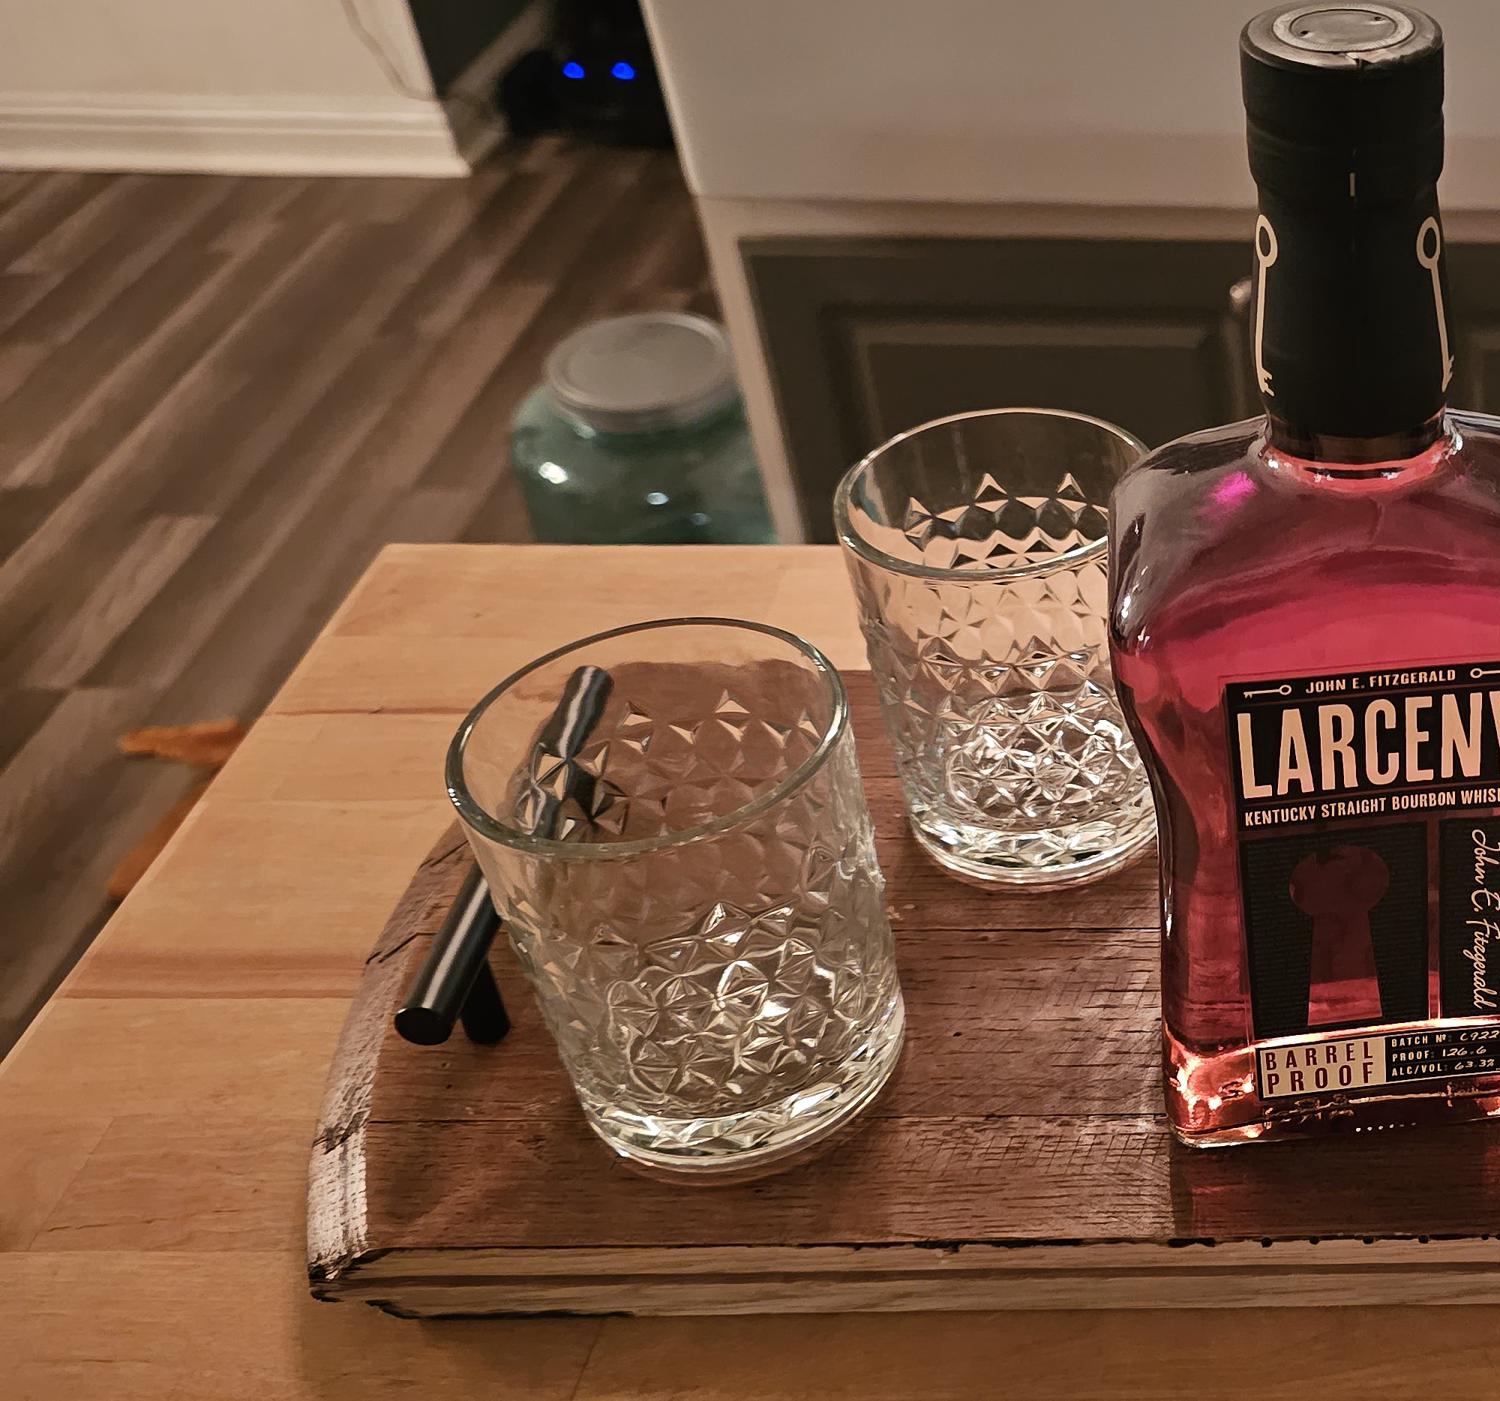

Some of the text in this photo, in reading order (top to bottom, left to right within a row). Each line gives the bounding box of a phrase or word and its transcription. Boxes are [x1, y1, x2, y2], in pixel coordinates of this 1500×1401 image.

[1305, 669, 1456, 694] JOHN E. FITZGERALD
[1245, 806, 1316, 827] KENTUCKY
[1321, 798, 1387, 818] STRAIGHT
[1392, 791, 1456, 810] BOURBON
[1471, 887, 1500, 912] E.
[1463, 918, 1500, 1010] Fitzgerald
[1391, 1035, 1428, 1048] BATCH
[1442, 1045, 1487, 1057] 126.6
[1265, 1041, 1373, 1070] BARREL
[1267, 1062, 1374, 1095] PROOF
